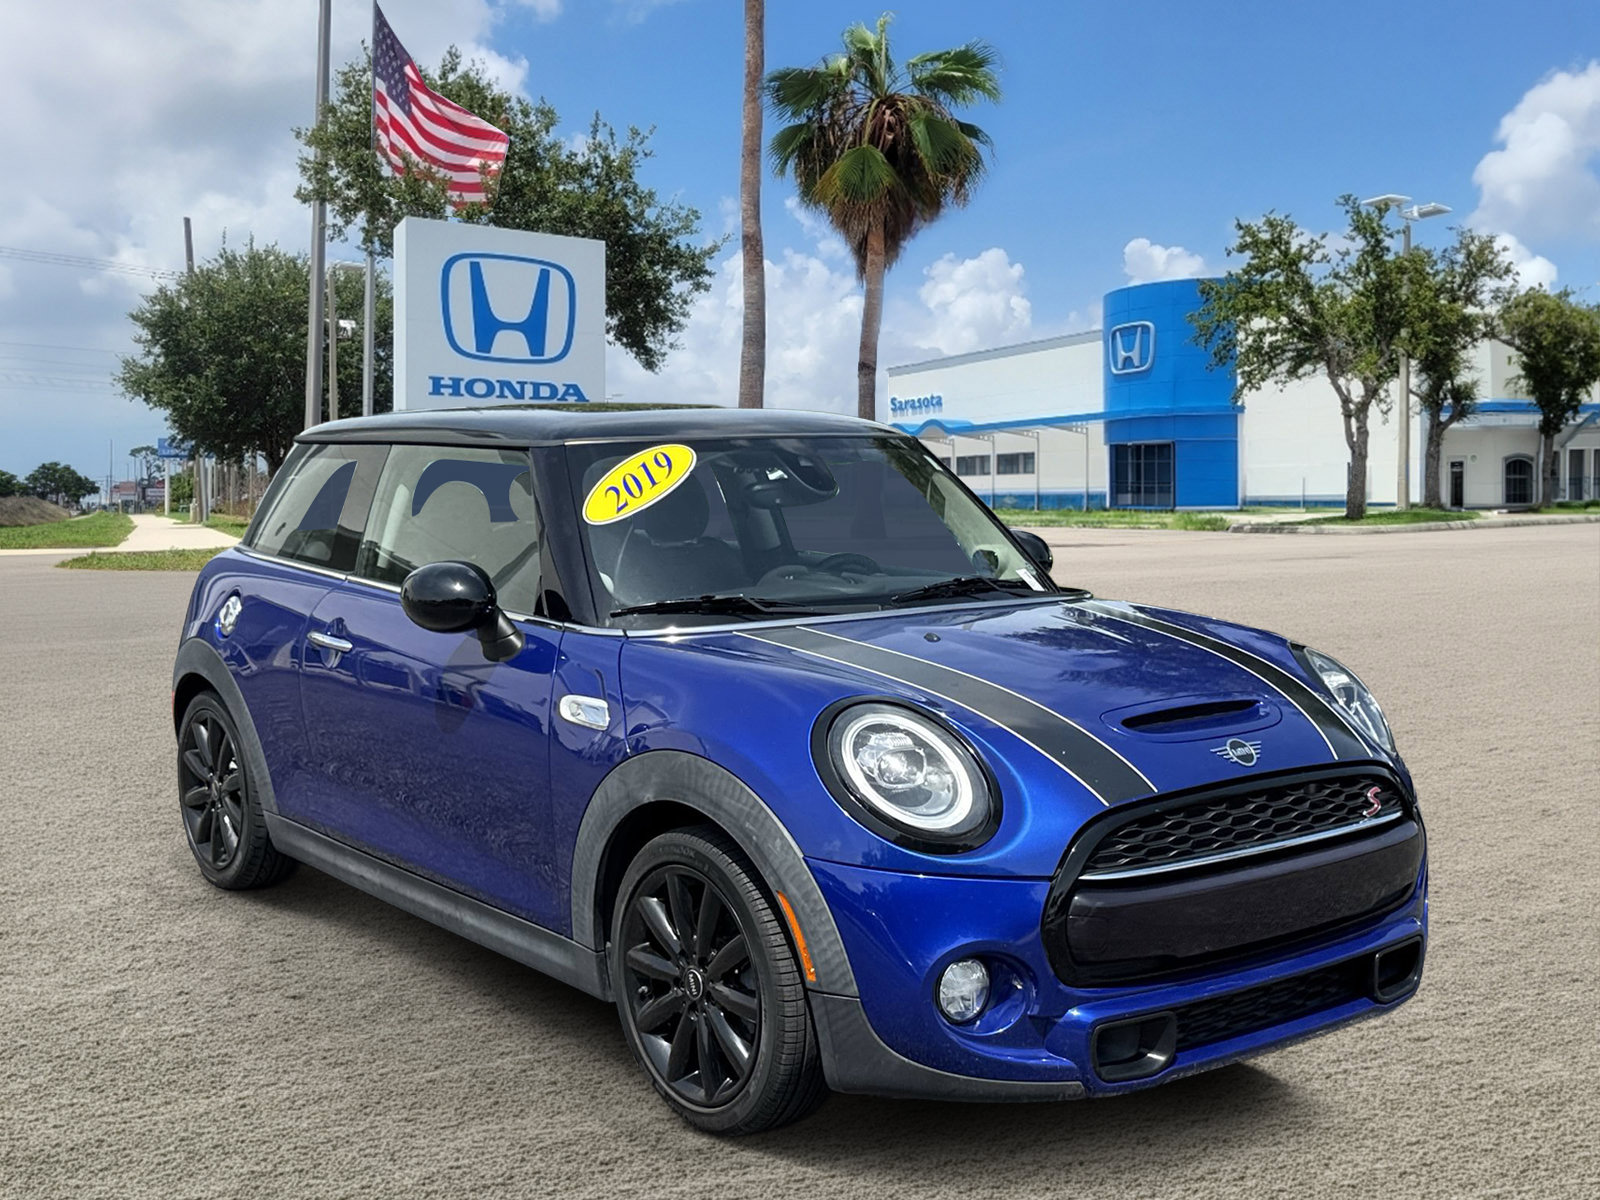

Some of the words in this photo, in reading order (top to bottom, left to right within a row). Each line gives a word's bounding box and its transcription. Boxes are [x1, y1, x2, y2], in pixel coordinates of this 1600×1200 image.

[428, 375, 589, 402] HONDA
[890, 394, 943, 412] Sarasota
[604, 451, 672, 514] 2019
[1362, 786, 1381, 817] S
[688, 973, 698, 995] MINI
